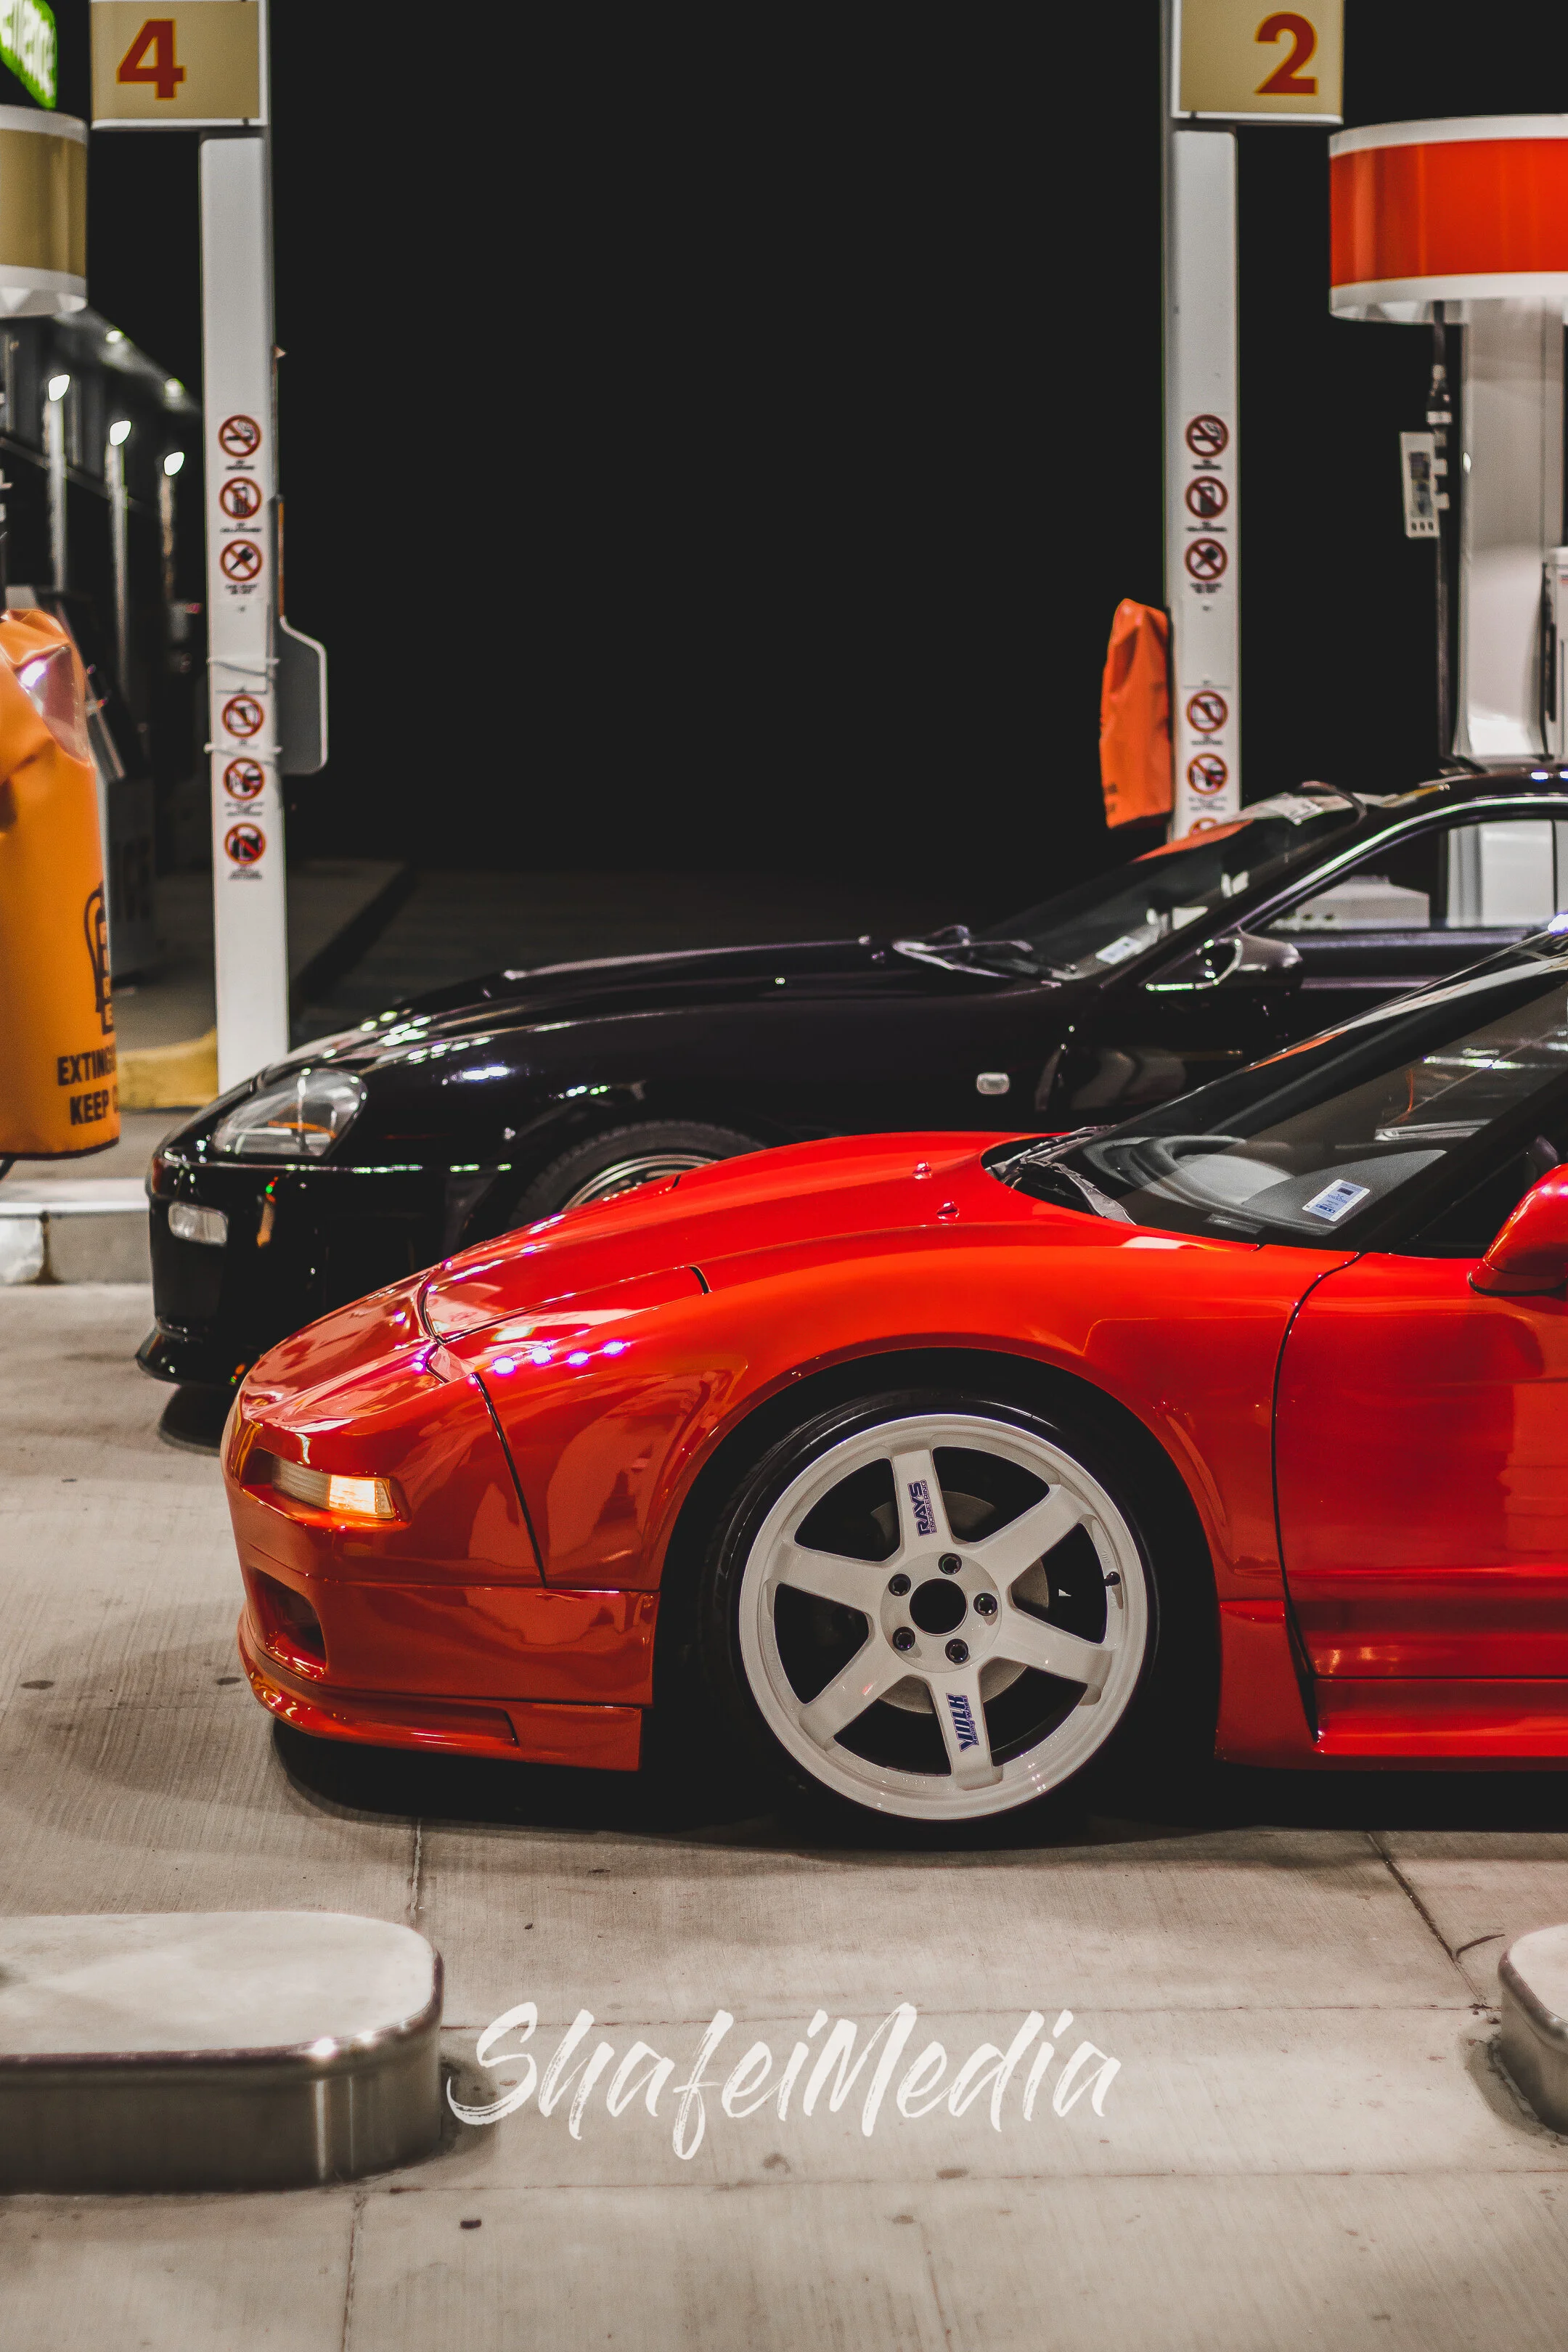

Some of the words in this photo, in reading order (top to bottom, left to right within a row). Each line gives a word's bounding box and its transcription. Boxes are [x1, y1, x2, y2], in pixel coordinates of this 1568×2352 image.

[116, 18, 187, 100] 4
[1254, 11, 1319, 96] 2
[70, 1089, 109, 1126] KEEP
[907, 1481, 931, 1536] RAYS
[920, 1479, 937, 1533] ENGINEERING
[946, 1693, 974, 1752] VOLK
[960, 1694, 973, 1720] Wheel
[968, 1719, 979, 1746] Racing
